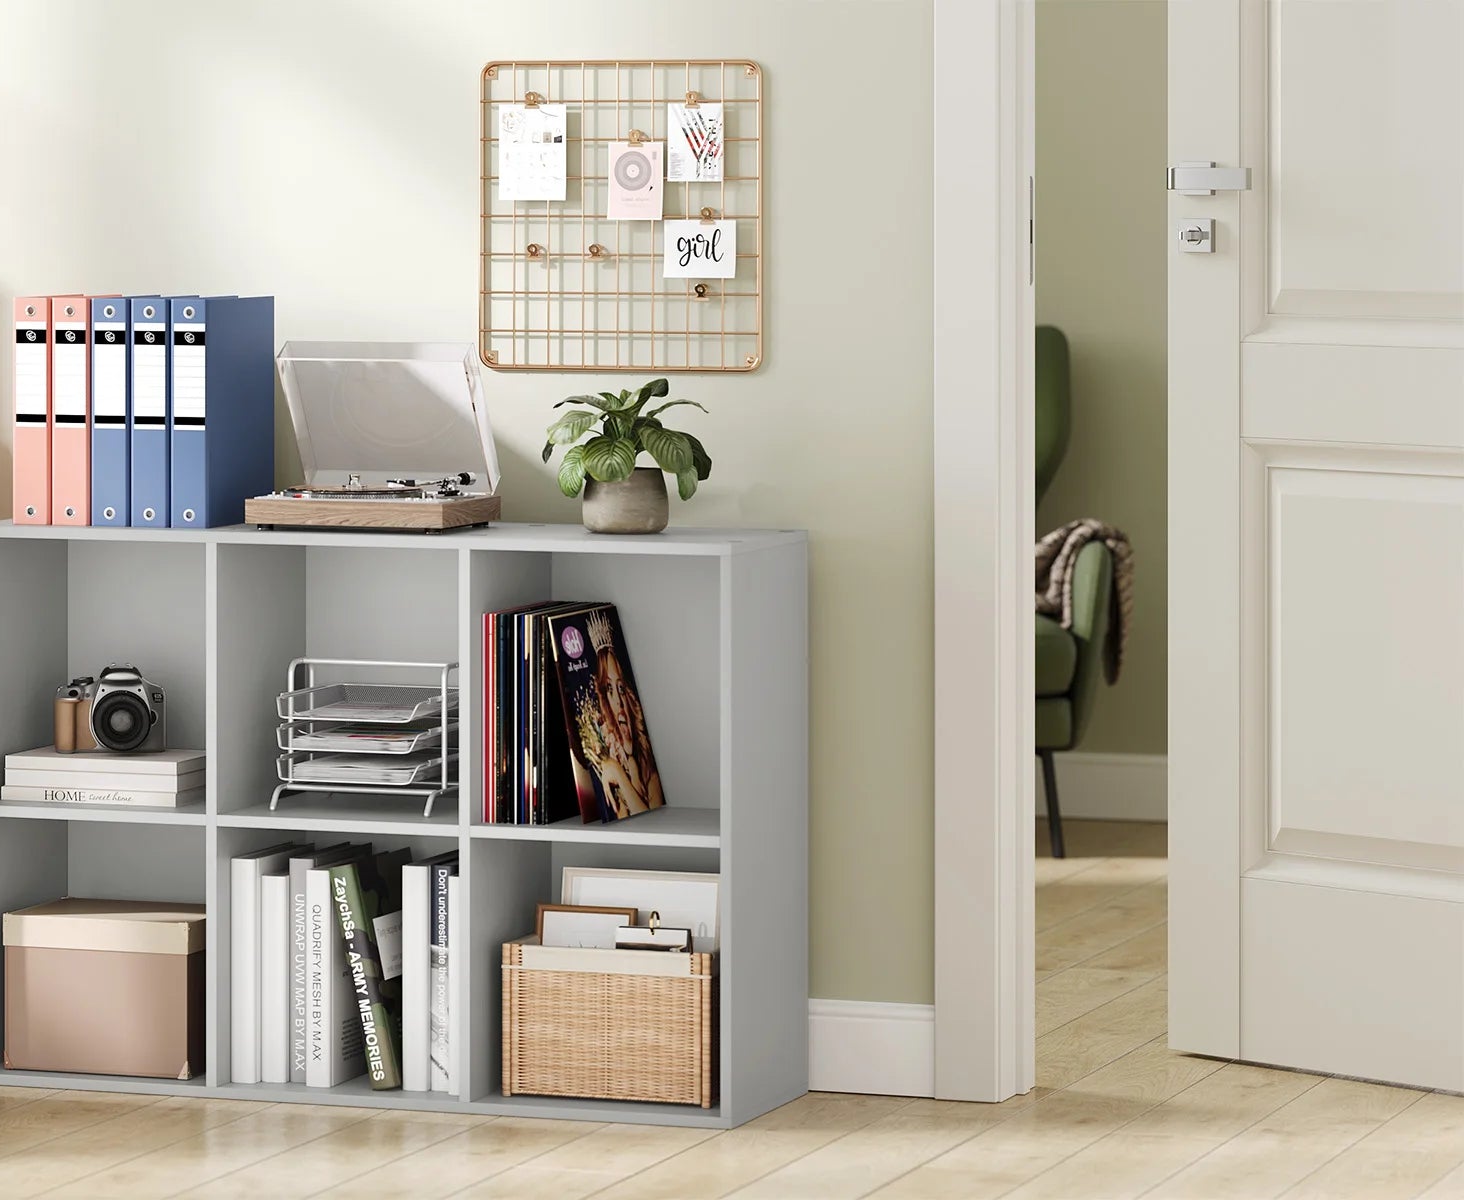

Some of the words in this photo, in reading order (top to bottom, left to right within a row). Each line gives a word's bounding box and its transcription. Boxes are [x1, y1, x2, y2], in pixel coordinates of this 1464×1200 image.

[676, 228, 725, 267] girl
[44, 789, 86, 802] HOME
[88, 792, 111, 802] sweet
[112, 791, 133, 802] home
[438, 869, 448, 895] Don't
[294, 893, 306, 951] UNWRAP
[312, 904, 322, 969] QUADRIFY
[438, 897, 448, 964] underestimate
[294, 954, 305, 985] UVW
[334, 876, 355, 940] ZaychSa
[348, 951, 368, 996] ARMY
[358, 998, 385, 1081] MEMORIES
[438, 966, 447, 982] the
[295, 987, 305, 1016] MAP
[312, 971, 322, 1007] MESH
[295, 1018, 305, 1037] BY
[312, 1011, 322, 1028] BY
[294, 1039, 305, 1071] M.AX
[312, 1030, 322, 1061] M.AX
